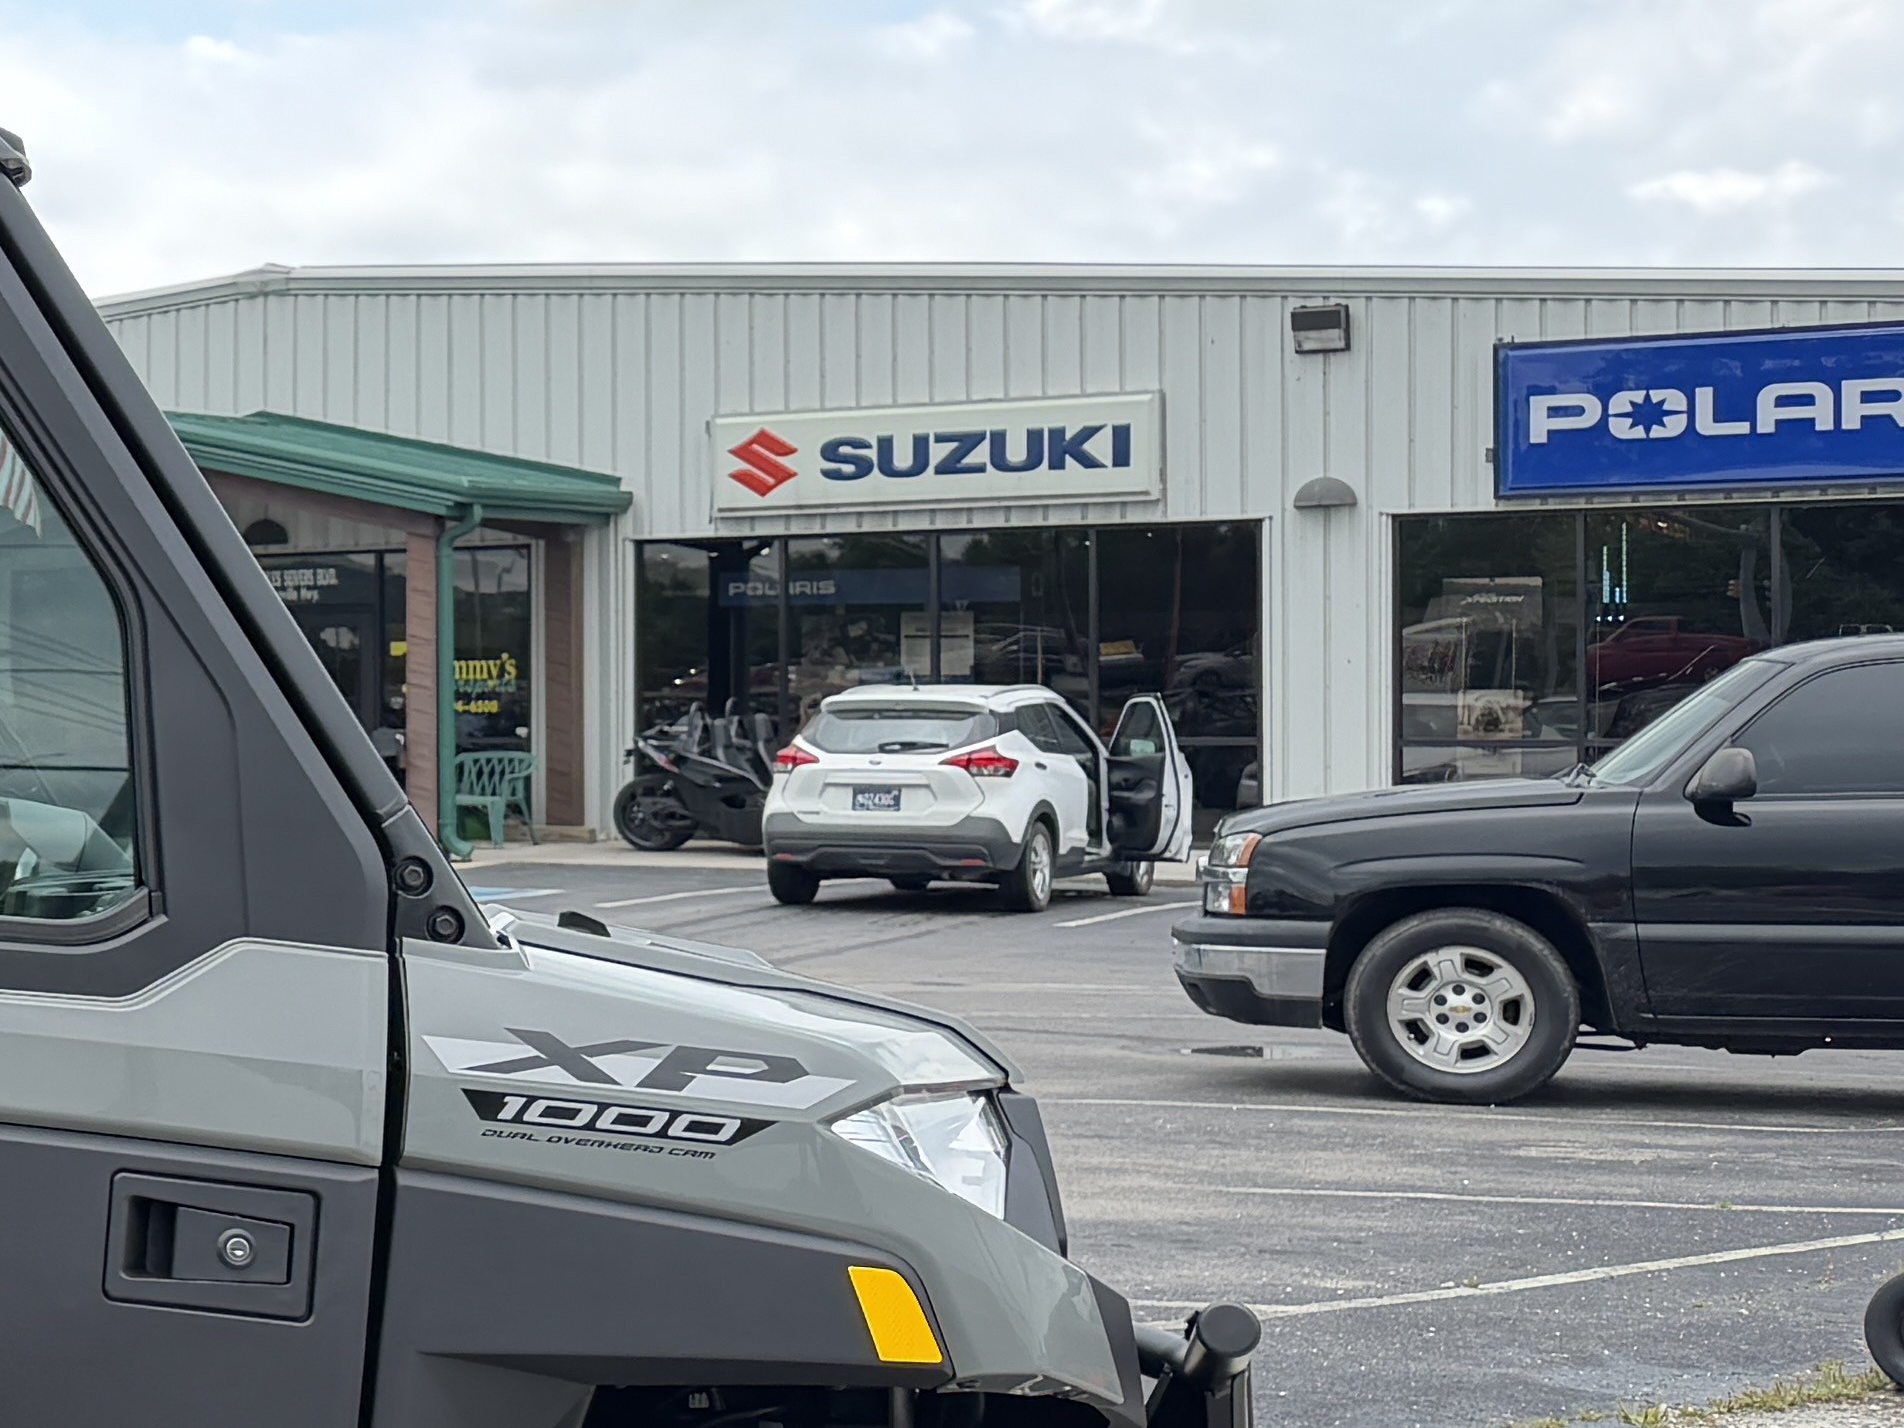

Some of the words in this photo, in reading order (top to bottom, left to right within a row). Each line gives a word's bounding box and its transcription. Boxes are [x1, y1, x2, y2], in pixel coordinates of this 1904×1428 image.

[1528, 377, 1904, 445] POLAR
[819, 423, 1131, 481] SUZUKI
[728, 580, 836, 596] POLRIS
[459, 1028, 810, 1092] XP
[481, 1128, 541, 1142] DUAL
[547, 1136, 664, 1154] OVERHEAD
[668, 1147, 716, 1160] CAM
[496, 1095, 741, 1143] 1000
